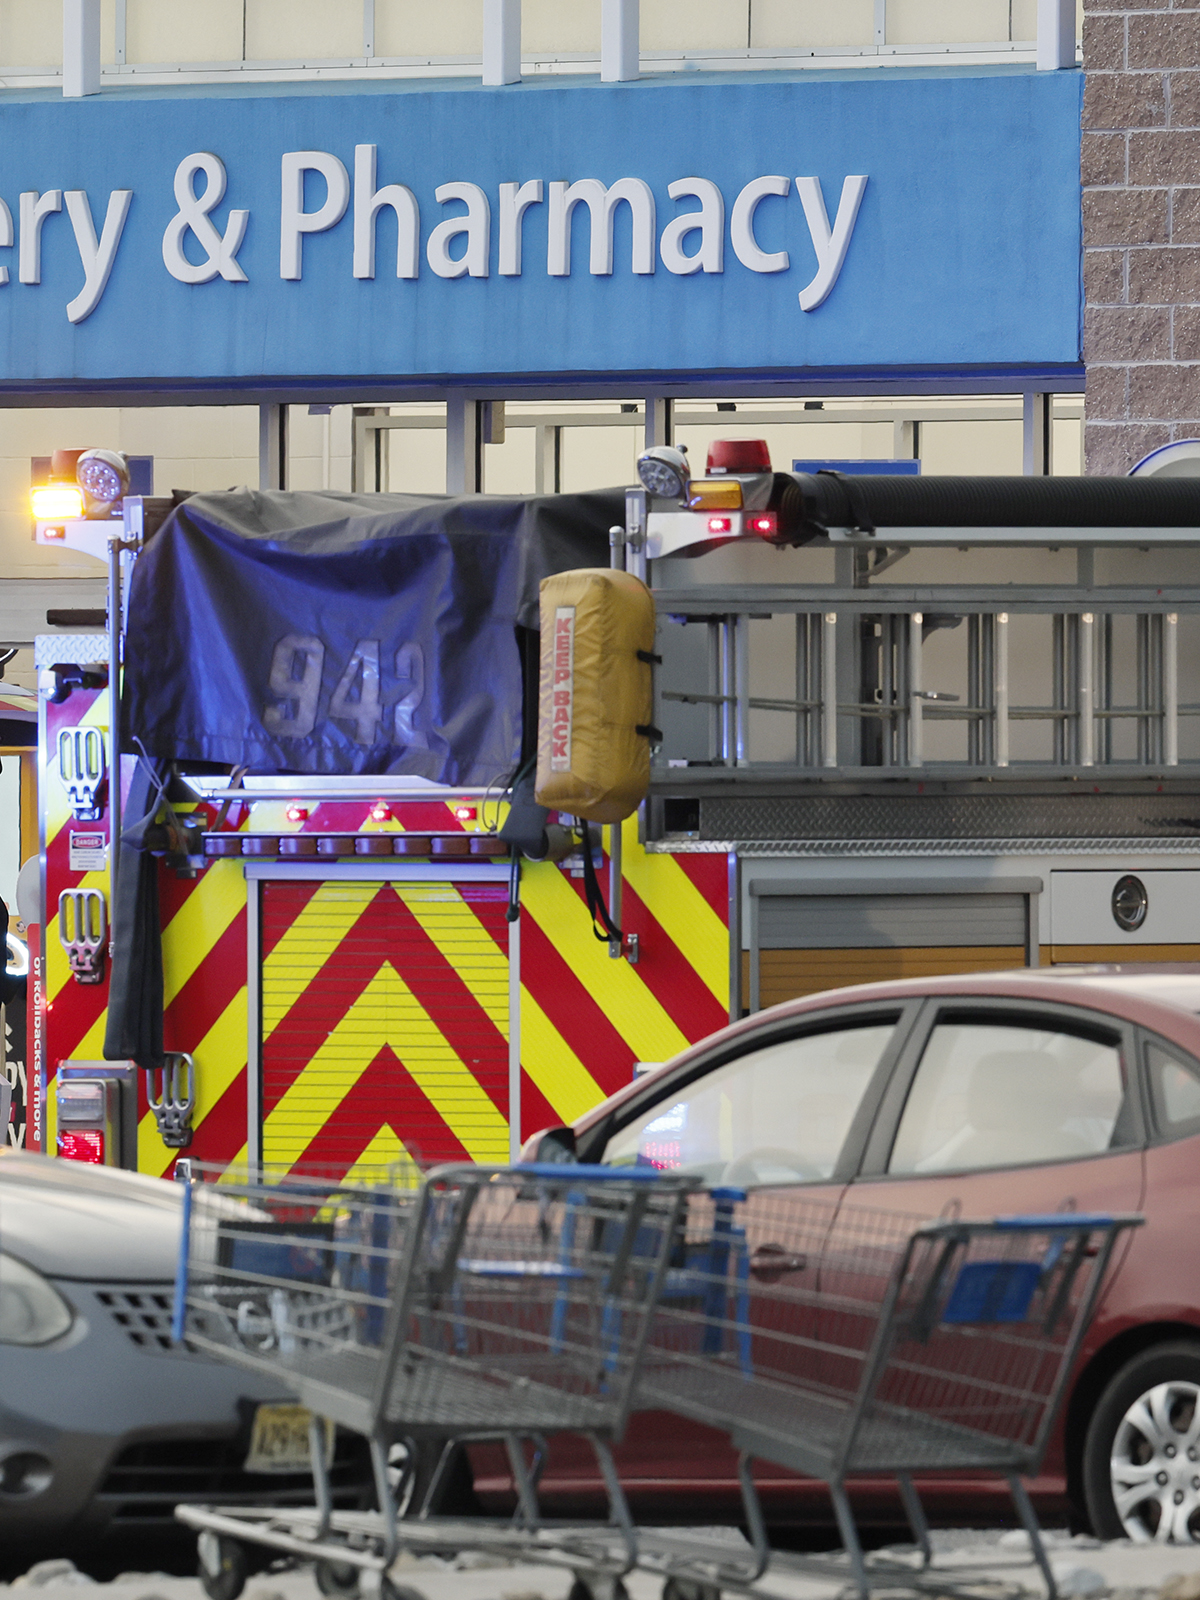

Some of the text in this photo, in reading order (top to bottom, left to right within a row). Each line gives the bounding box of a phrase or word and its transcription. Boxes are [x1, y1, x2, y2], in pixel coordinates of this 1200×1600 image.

[162, 151, 250, 285] &
[279, 143, 869, 312] Pharmacy
[554, 617, 572, 685] KEEP
[261, 634, 429, 750] 942
[552, 690, 570, 758] BACK
[75, 838, 99, 846] DANGER
[33, 980, 41, 1071] Rollbacks
[33, 1072, 41, 1088] &
[33, 1090, 41, 1141] more
